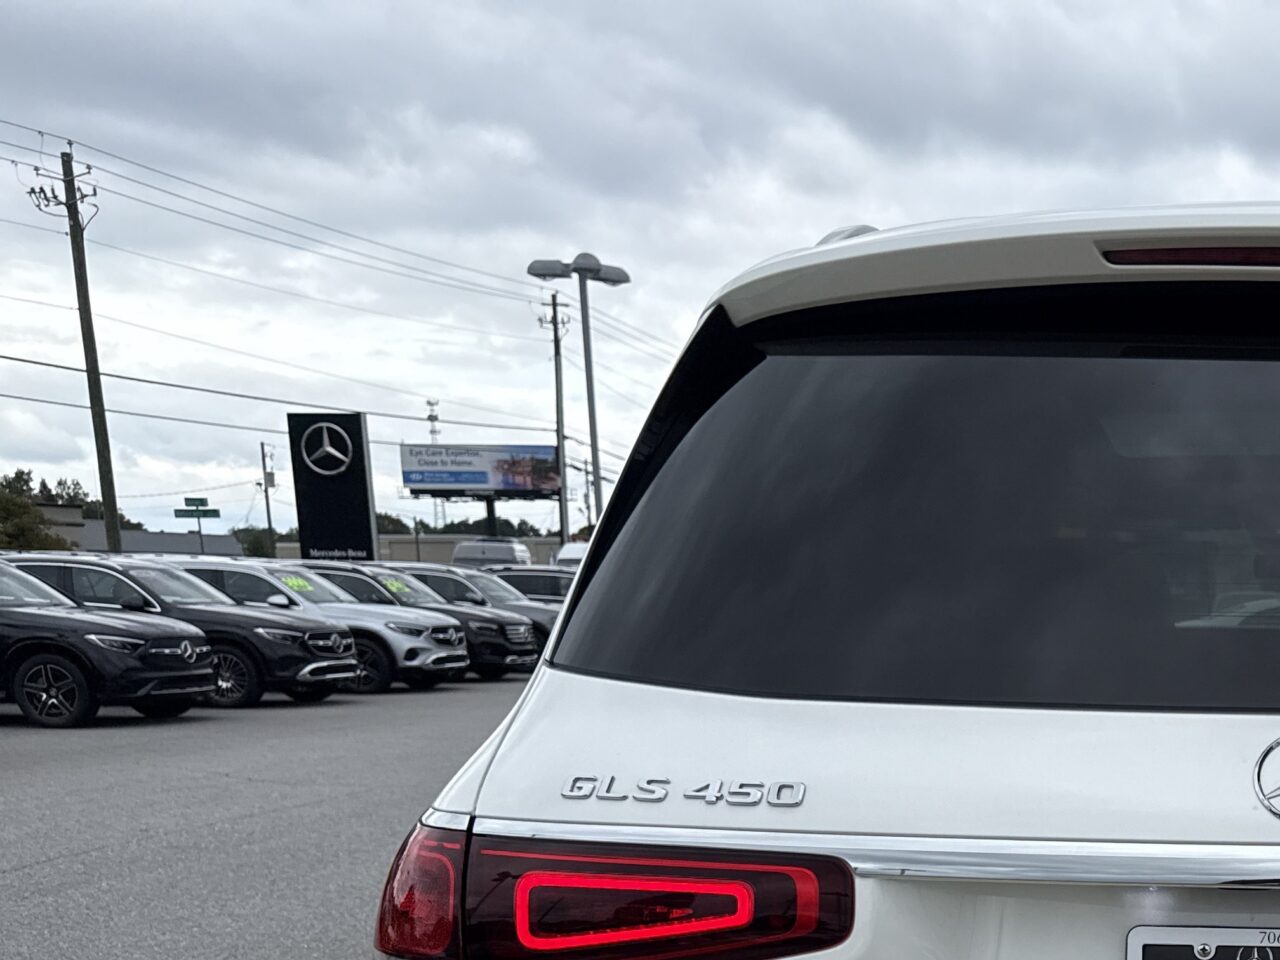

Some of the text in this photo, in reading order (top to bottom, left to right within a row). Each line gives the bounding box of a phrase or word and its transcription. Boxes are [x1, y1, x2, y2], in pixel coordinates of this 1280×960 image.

[409, 448, 423, 458] Eye
[425, 448, 443, 457] Care
[417, 458, 439, 467] Close
[440, 458, 449, 466] to
[561, 775, 806, 807] GLS 450
